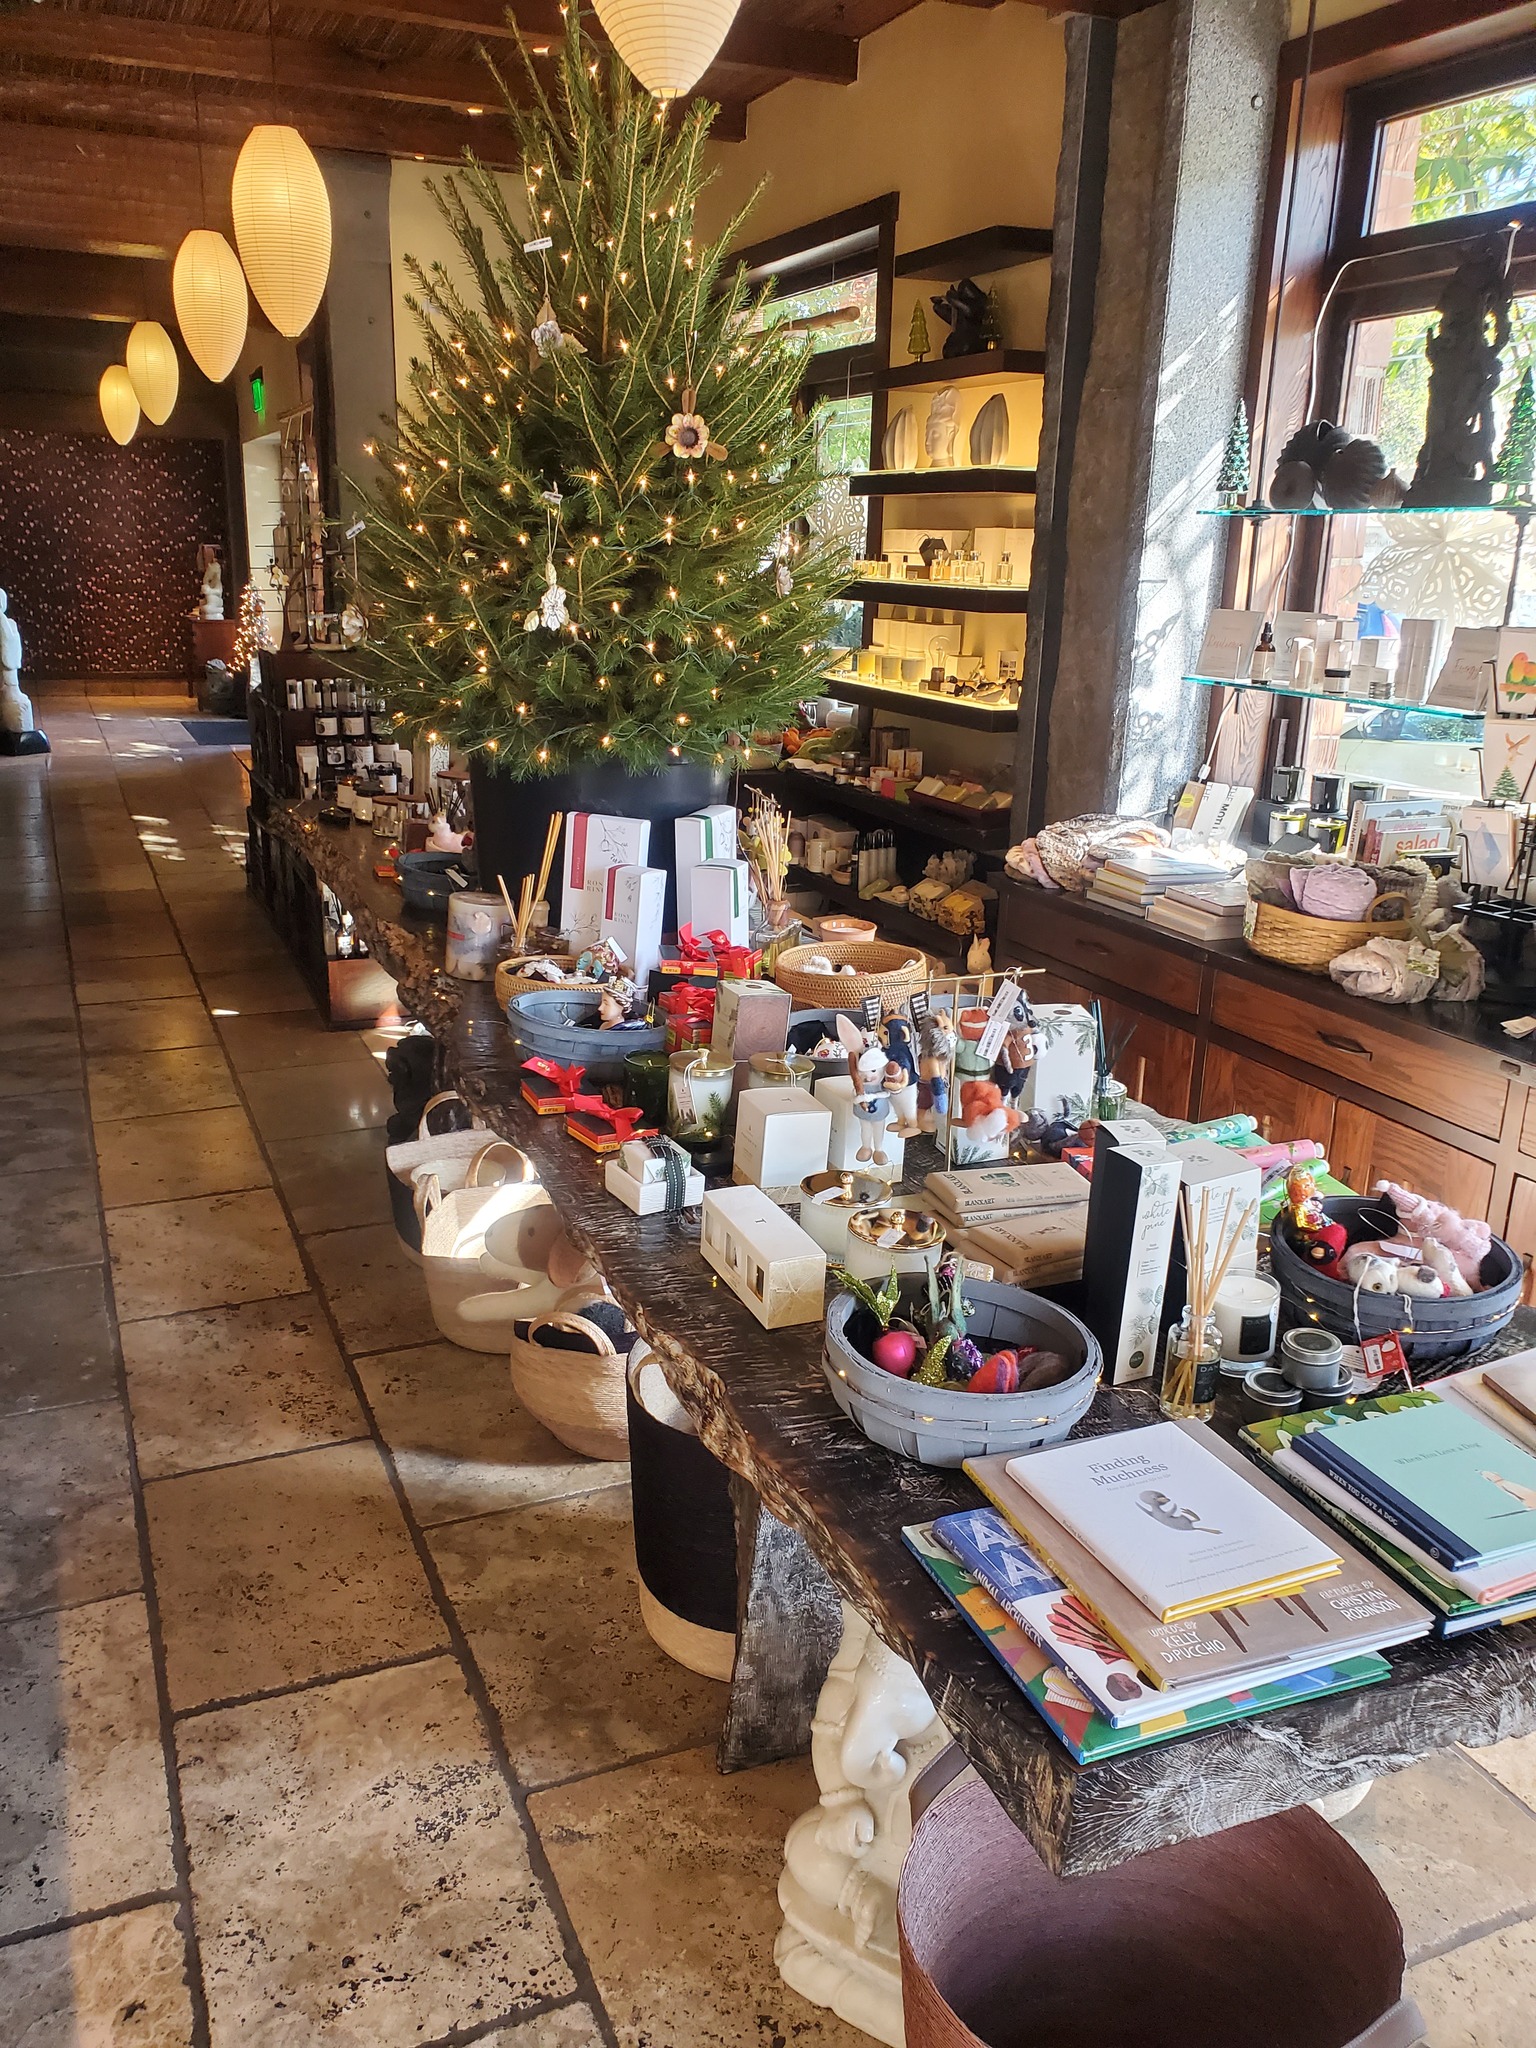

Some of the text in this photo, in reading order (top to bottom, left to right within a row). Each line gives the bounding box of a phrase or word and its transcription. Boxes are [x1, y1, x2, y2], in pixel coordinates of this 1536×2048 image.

[1396, 833, 1440, 852] salad
[965, 1198, 995, 1207] BLANXART
[1142, 1200, 1173, 1220] white
[964, 1213, 993, 1223] BLANXART
[1141, 1220, 1166, 1241] pine
[1087, 1455, 1151, 1474] Finding
[1090, 1462, 1168, 1486] Muchness
[1329, 1468, 1348, 1487] WHEN
[1347, 1484, 1361, 1497] YOU
[1360, 1493, 1378, 1511] LOVE
[1383, 1511, 1399, 1526] DOG
[1047, 1558, 1081, 1598] Gaston
[1319, 1579, 1376, 1600] PICTURES BY
[1329, 1589, 1389, 1610] CHRISTIAN
[972, 1568, 1043, 1648] ANIMAL ARCHITECTS
[1340, 1600, 1402, 1622] ROBINSON
[1148, 1620, 1198, 1638] WORDS BY
[1163, 1631, 1201, 1648] KELLY
